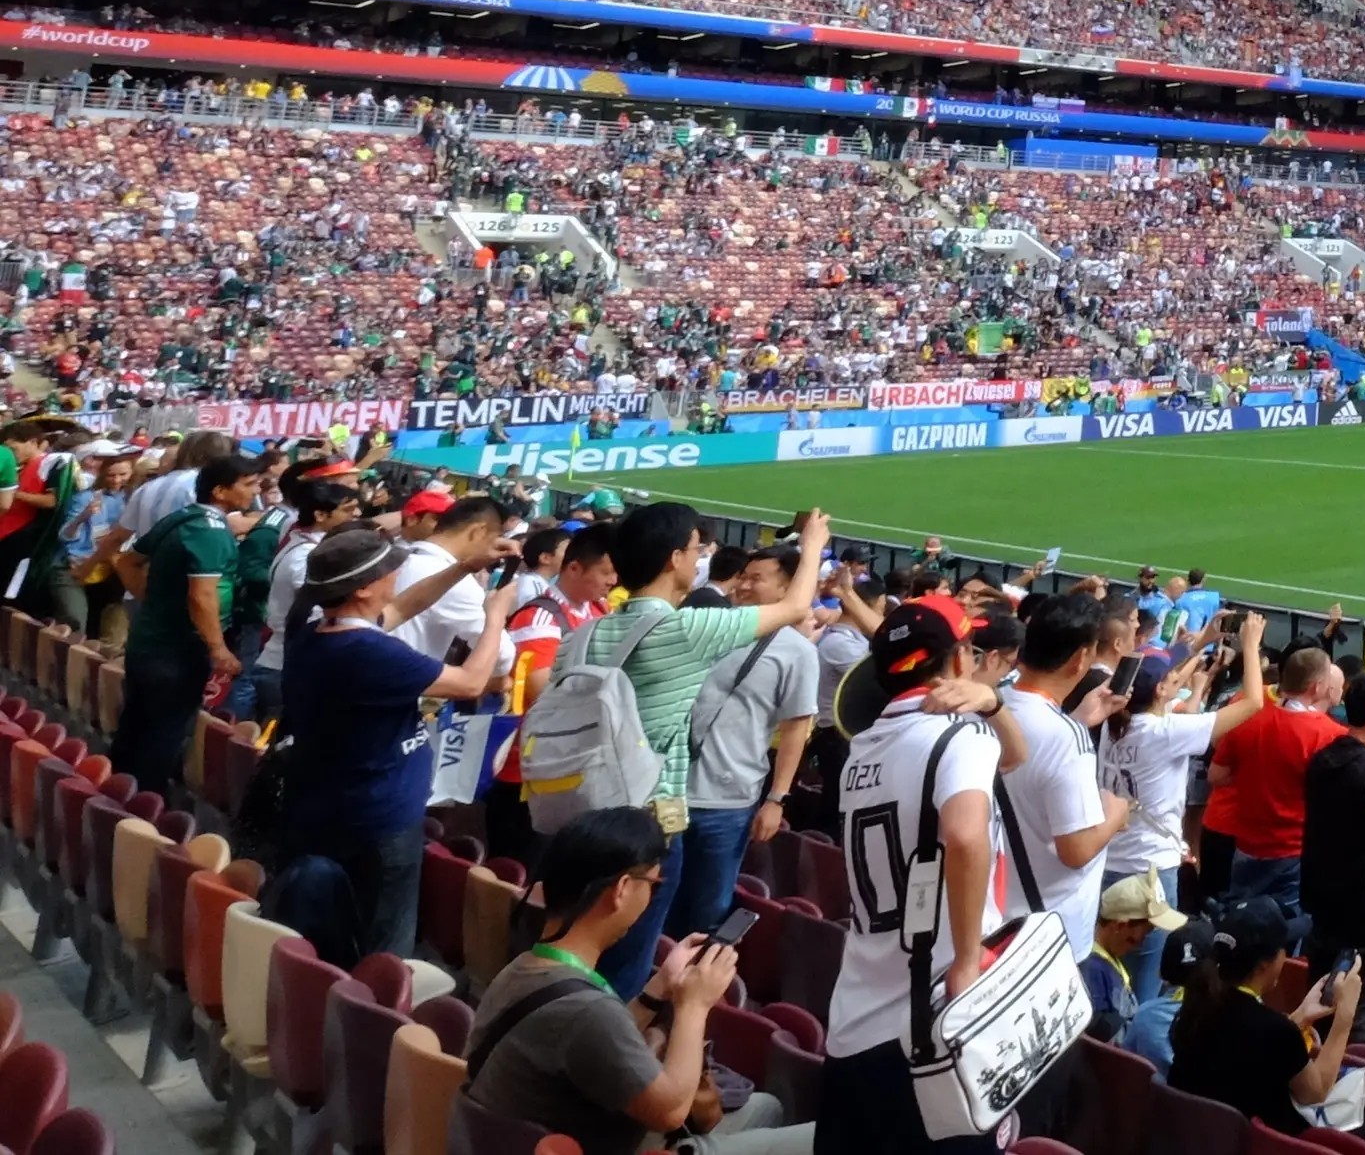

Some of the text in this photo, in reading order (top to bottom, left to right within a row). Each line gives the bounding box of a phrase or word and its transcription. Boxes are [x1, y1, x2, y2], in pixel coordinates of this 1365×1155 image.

[20, 26, 150, 51] #worldcup
[939, 103, 985, 119] WORLD
[986, 107, 1014, 121] CUP
[1015, 110, 1061, 125] RUSSIA
[477, 220, 560, 233] 126 125
[994, 234, 1014, 246] 123
[727, 386, 866, 409] BRACHELEN
[964, 380, 1016, 400] Zwiesel
[228, 400, 402, 436] RATINGEN
[410, 395, 567, 428] TEMPLIN
[1094, 404, 1308, 439] VISA VISA VISA
[891, 422, 987, 452] GAZPROM
[478, 441, 701, 477] Hisense
[440, 718, 471, 769] VISA
